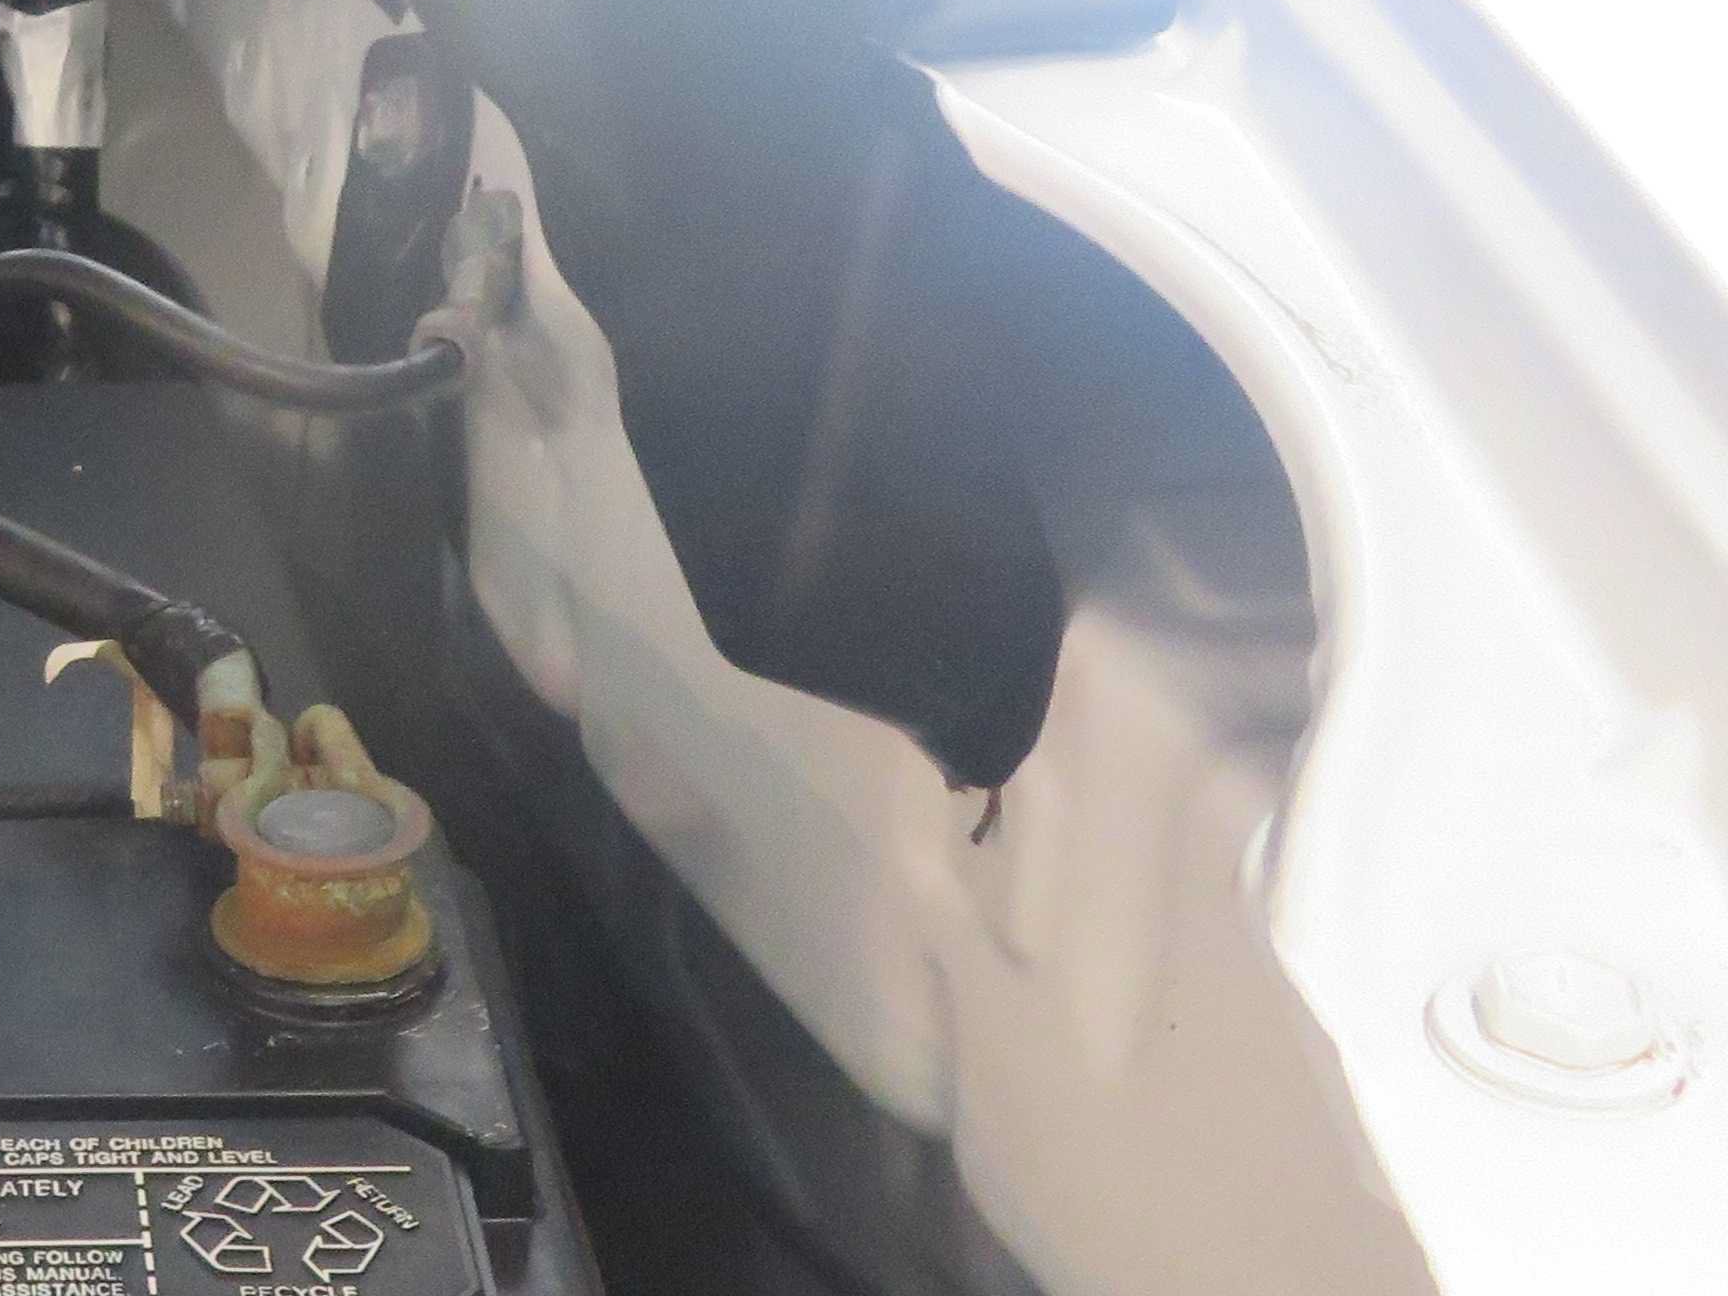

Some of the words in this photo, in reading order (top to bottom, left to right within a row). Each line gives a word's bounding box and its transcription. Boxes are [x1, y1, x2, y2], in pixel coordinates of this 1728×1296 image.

[69, 1137, 100, 1152] OF
[109, 1136, 224, 1151] CHILDREN
[4, 1152, 65, 1167] CAPS
[74, 1151, 142, 1166] TIGHT
[151, 1151, 200, 1166] AND
[208, 1150, 279, 1165] LEVEL
[159, 1174, 205, 1212] LEAD
[345, 1176, 421, 1232] RETURN
[33, 1249, 123, 1266] FOLLOW
[26, 1266, 123, 1282] MANUAL.
